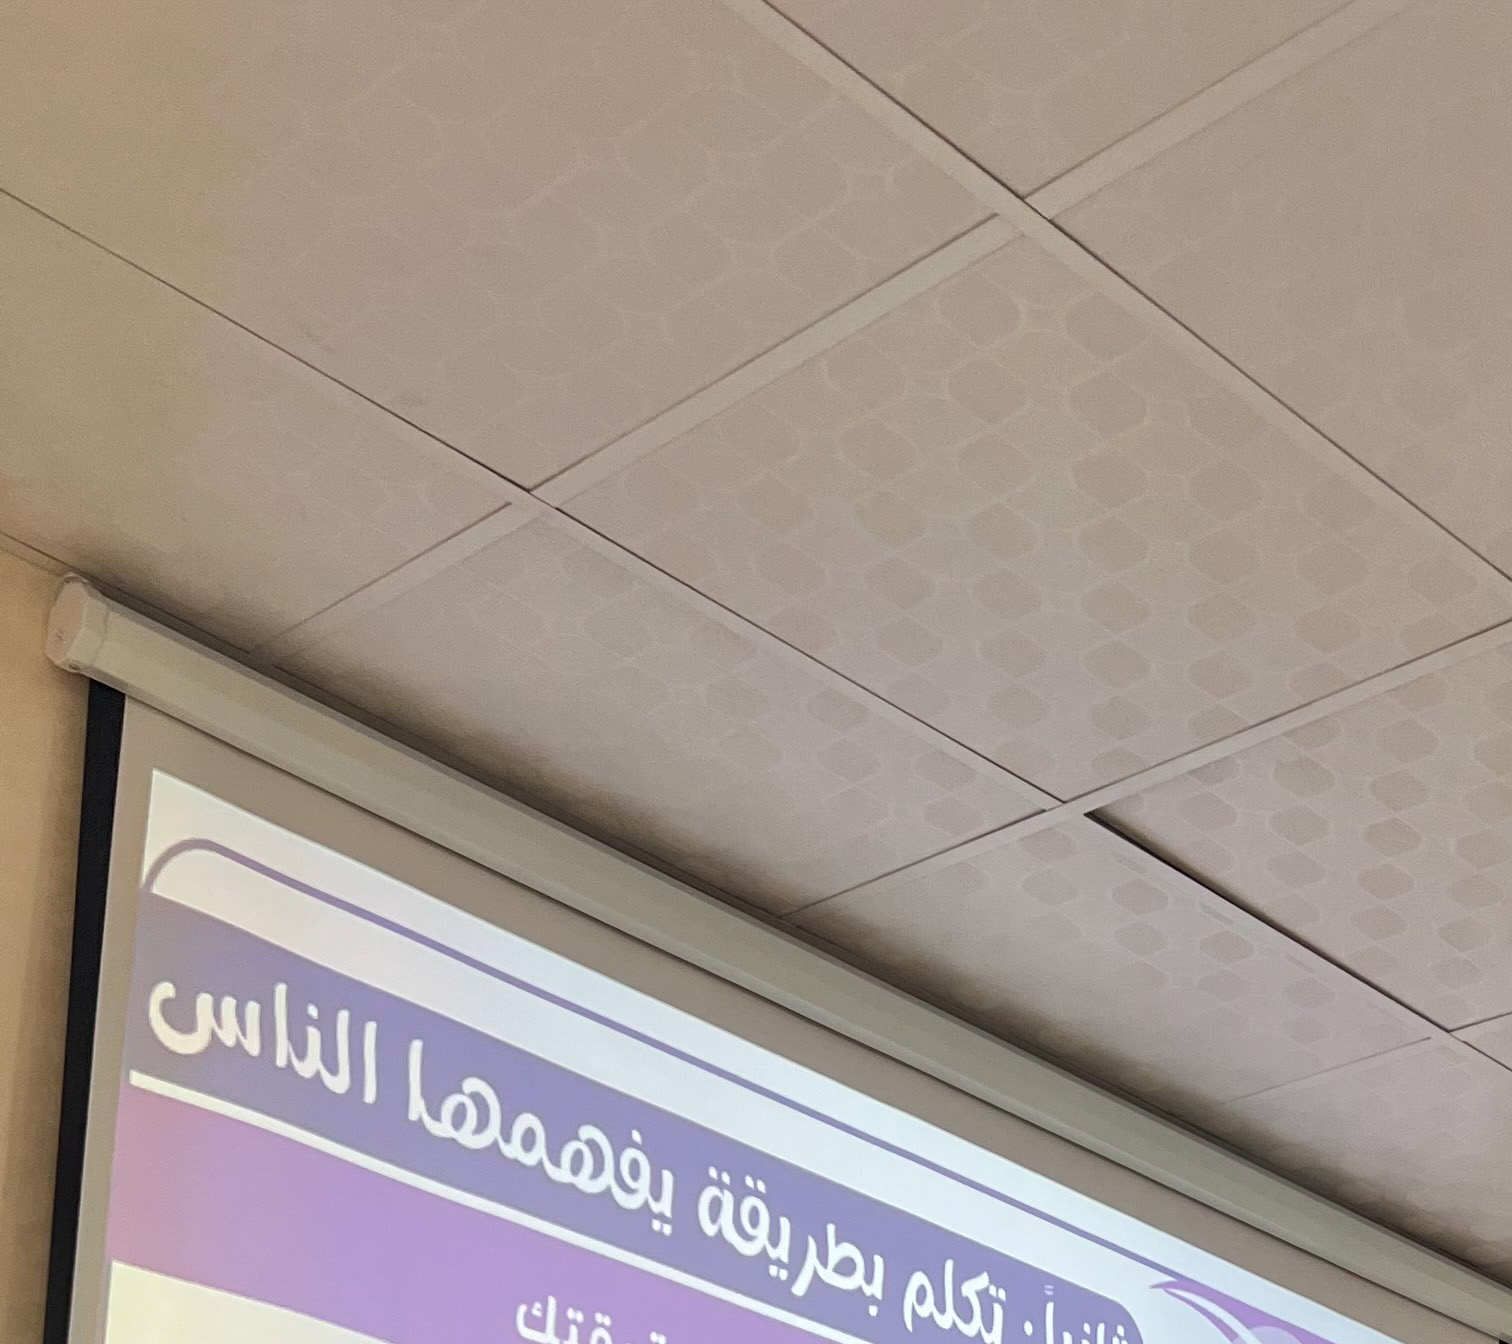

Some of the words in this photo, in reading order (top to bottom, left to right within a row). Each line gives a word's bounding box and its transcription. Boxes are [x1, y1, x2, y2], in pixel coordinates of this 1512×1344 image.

[149, 982, 377, 1104] الناس
[408, 1040, 674, 1236] يفهمها
[698, 1167, 885, 1317] بطريقة
